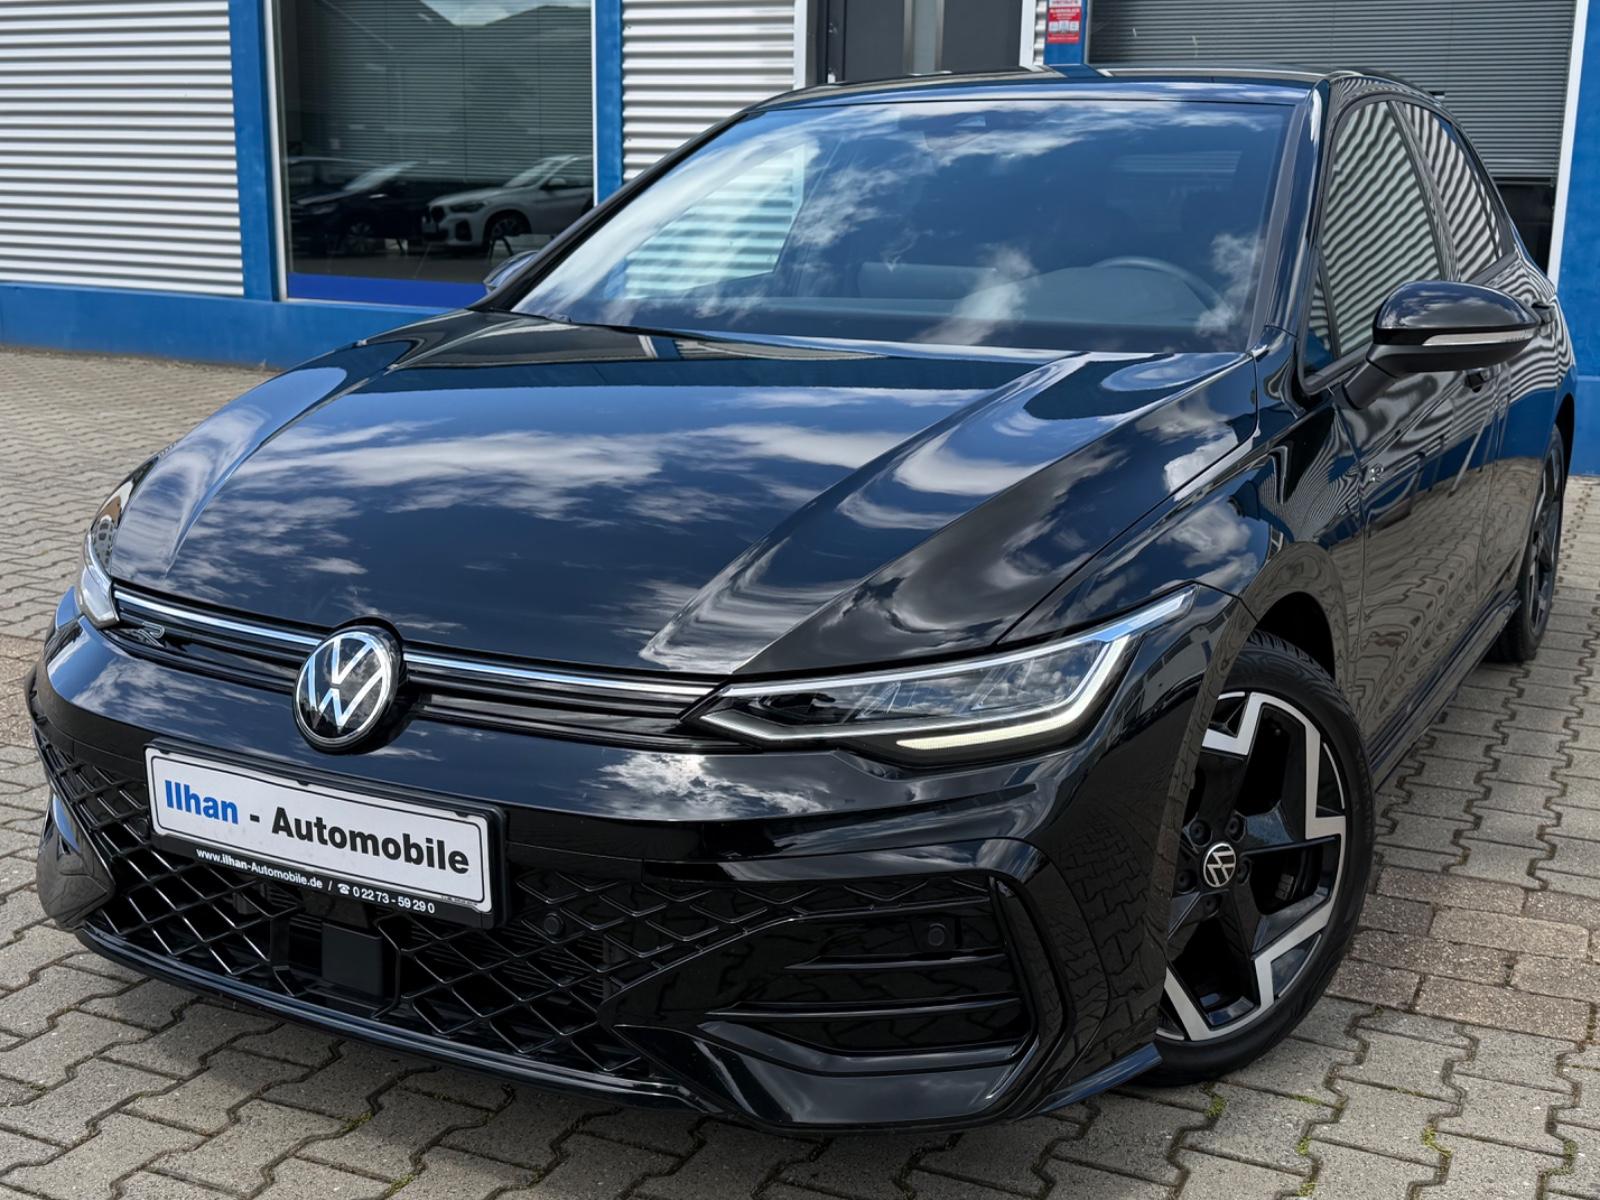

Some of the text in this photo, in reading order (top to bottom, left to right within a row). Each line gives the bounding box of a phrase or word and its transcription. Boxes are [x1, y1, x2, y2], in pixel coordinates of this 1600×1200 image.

[296, 630, 392, 743] VW
[165, 780, 239, 825] Ilhan
[271, 807, 470, 875] Automobile
[195, 848, 323, 889] www.ilhan-Automobile.de
